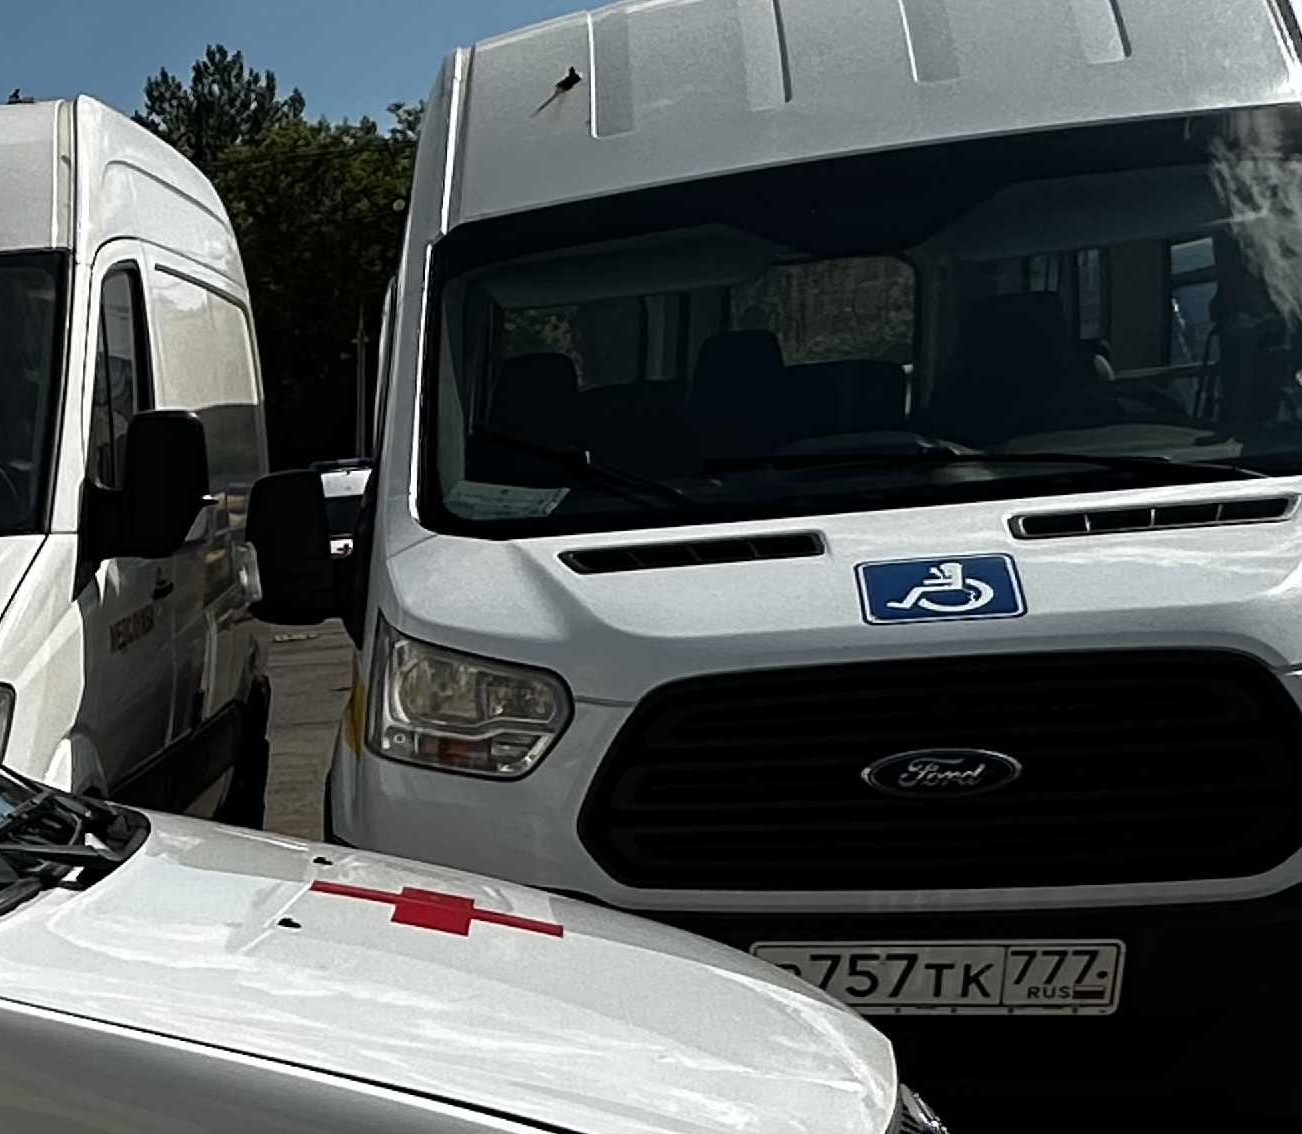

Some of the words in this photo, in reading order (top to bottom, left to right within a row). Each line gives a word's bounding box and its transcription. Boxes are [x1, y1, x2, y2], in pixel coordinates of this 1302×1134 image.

[898, 757, 985, 787] Ford
[776, 953, 993, 999] 757ТК
[1010, 950, 1101, 985] 777
[1027, 986, 1072, 1000] RUS
